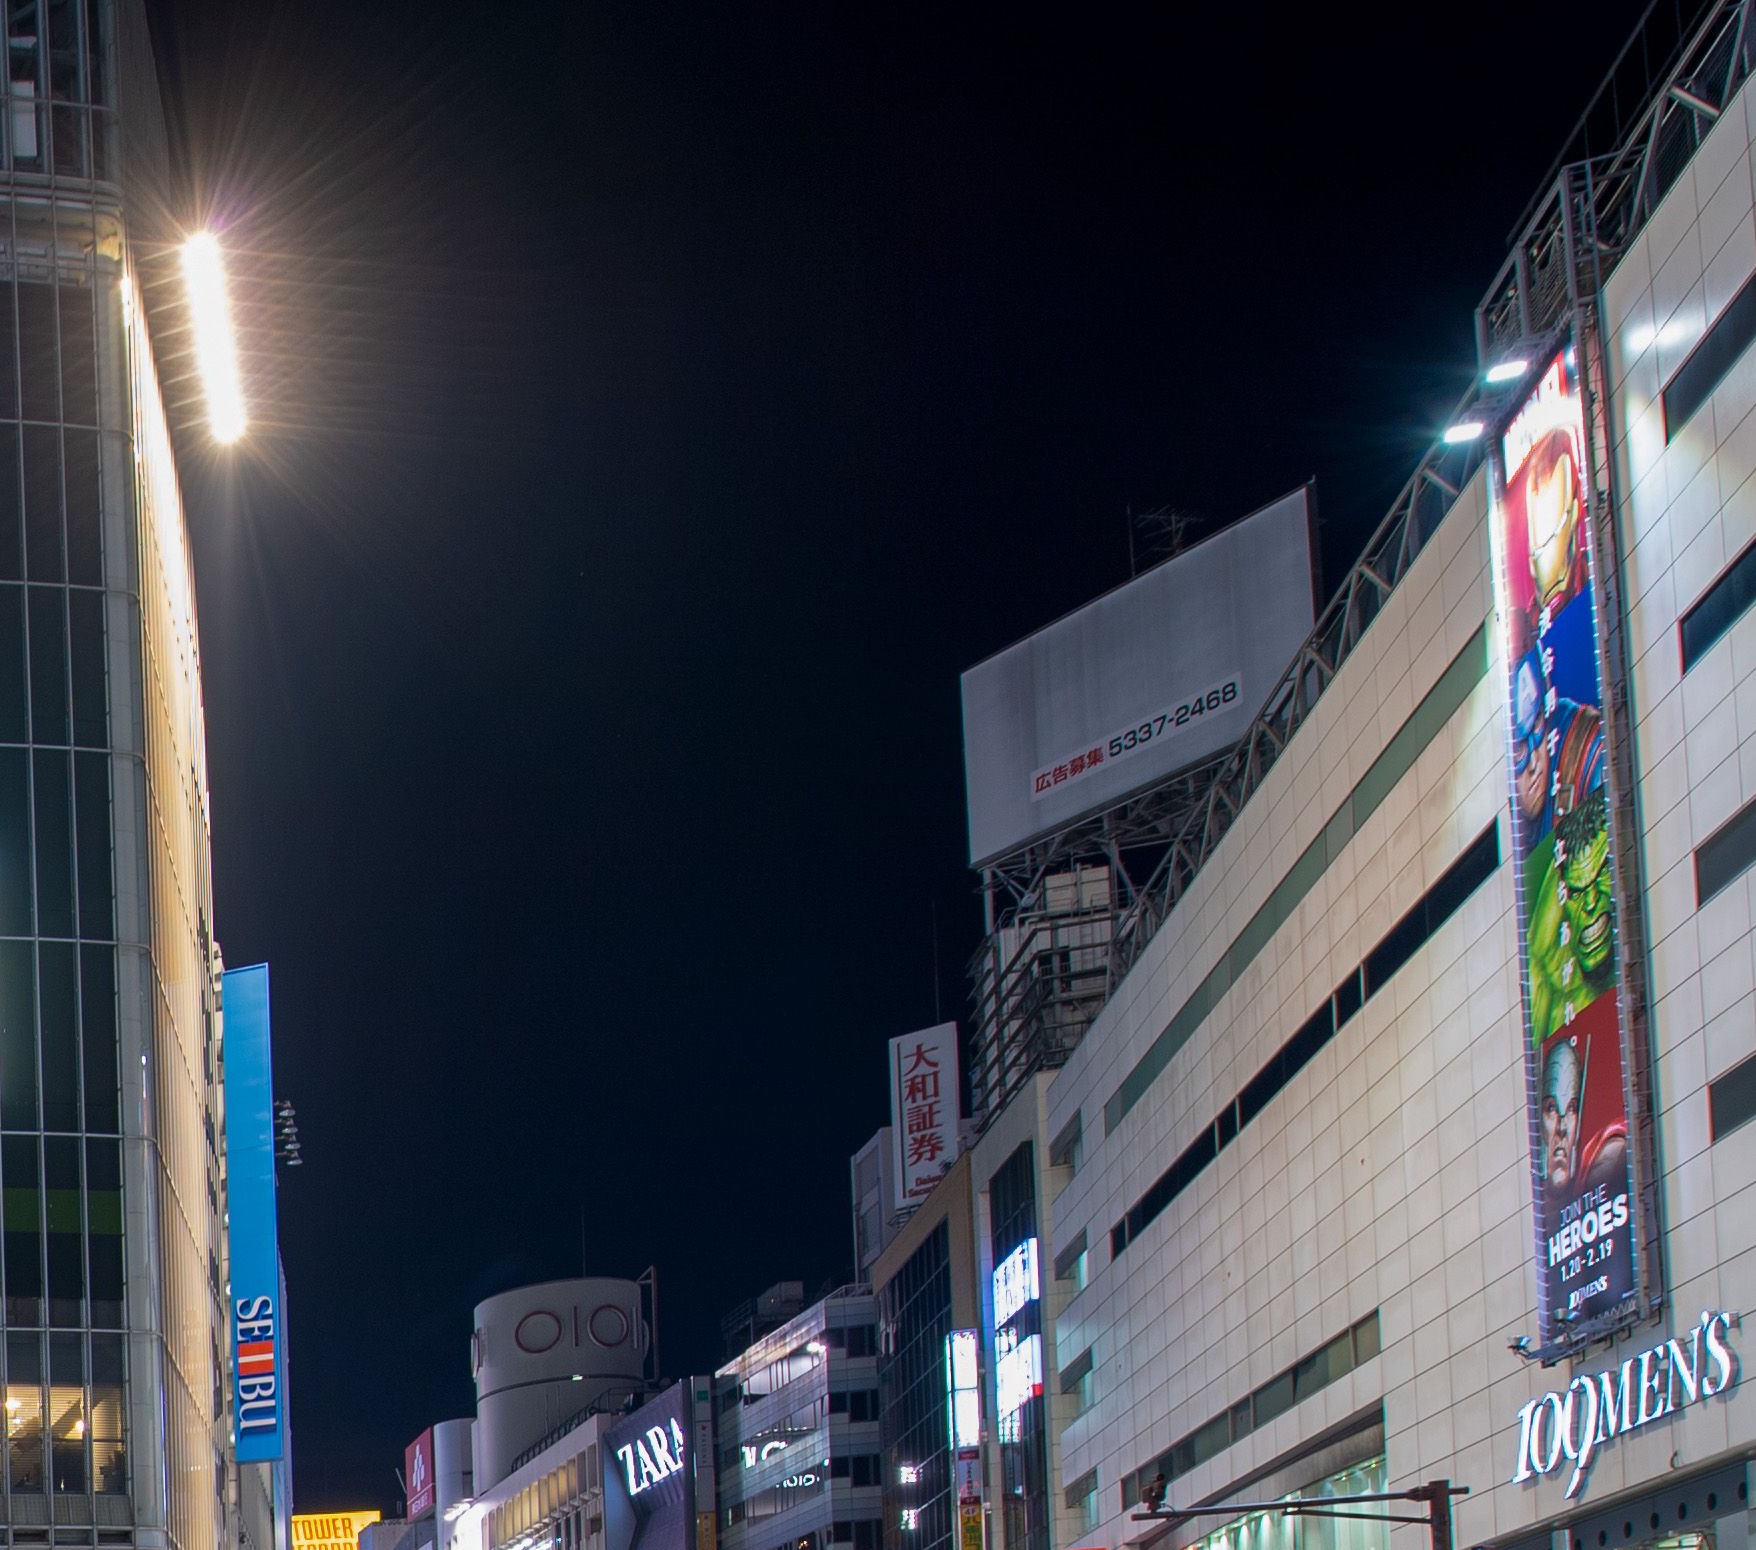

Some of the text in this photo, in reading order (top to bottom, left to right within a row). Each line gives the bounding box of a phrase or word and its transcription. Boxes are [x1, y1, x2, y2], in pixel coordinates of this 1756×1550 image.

[1035, 681, 1237, 793] 広告募集 5337-2468
[903, 1043, 944, 1168] 大和証券
[1548, 1193, 1628, 1267] HEROES
[1582, 1183, 1607, 1211] THE
[1561, 1238, 1614, 1283] 1.20-2.19
[236, 1296, 277, 1432] SEIBU
[617, 1417, 684, 1496] ZARA
[292, 1517, 354, 1541] TOWER
